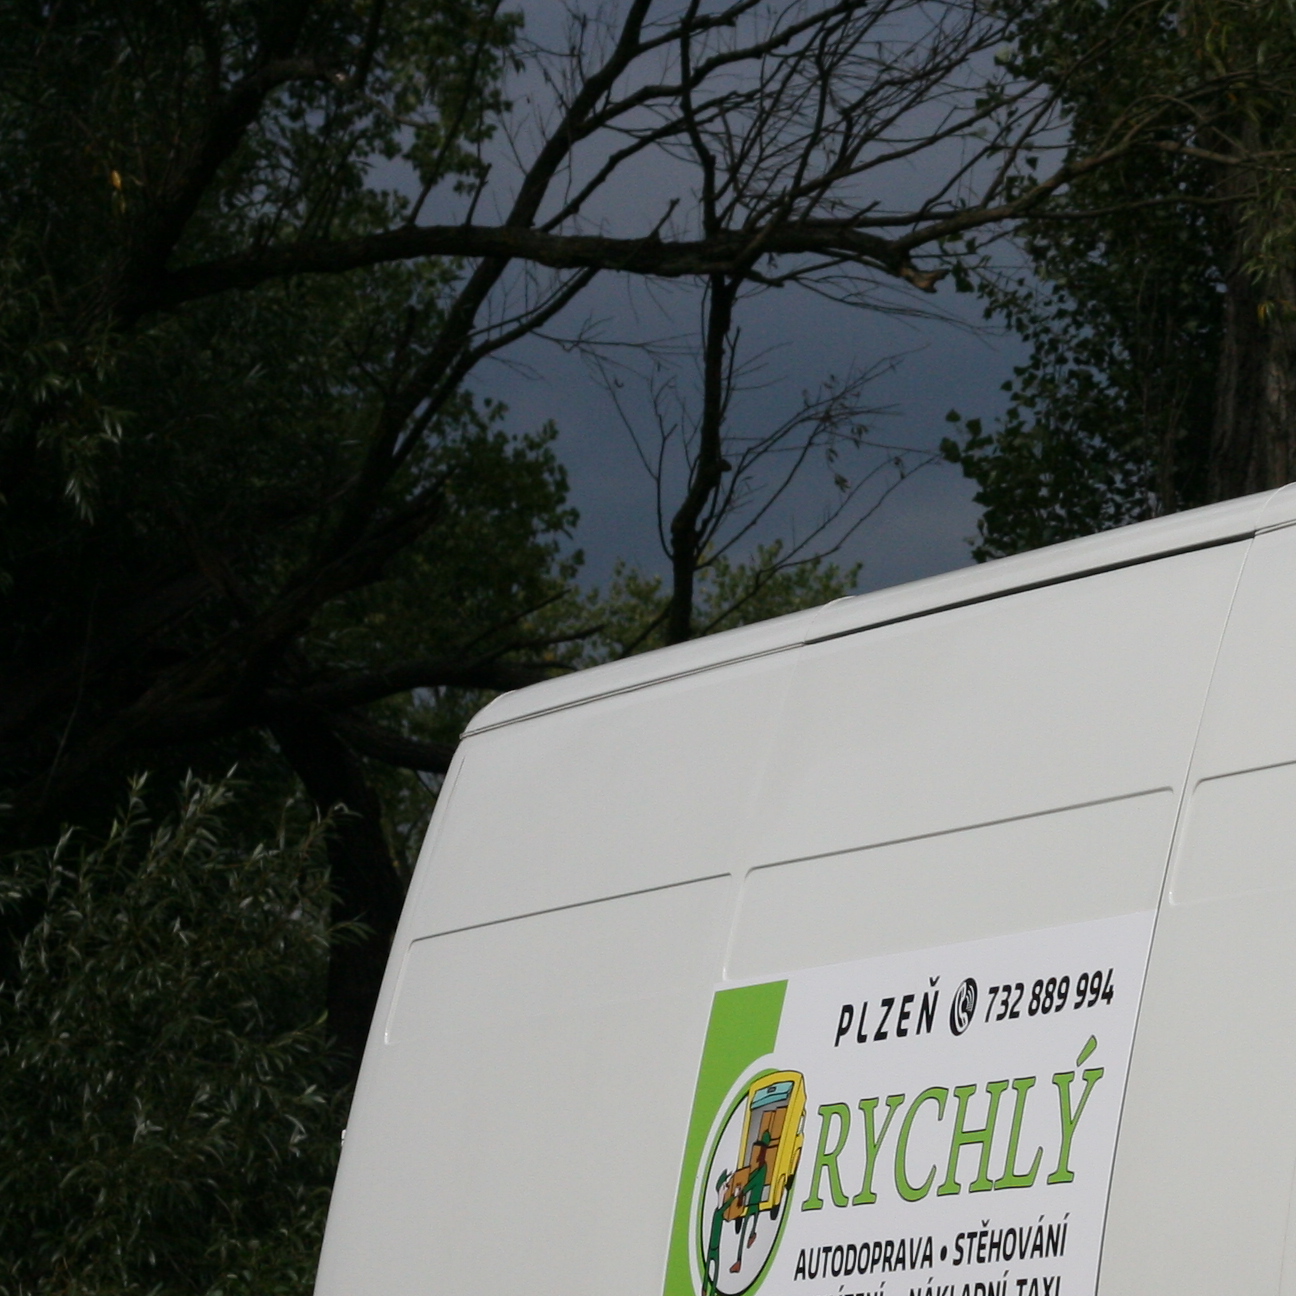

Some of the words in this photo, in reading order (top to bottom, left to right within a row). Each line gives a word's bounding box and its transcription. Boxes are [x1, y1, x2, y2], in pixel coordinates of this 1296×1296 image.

[834, 976, 940, 1047] PLZEŇ
[985, 983, 1023, 1023] 732
[1028, 975, 1071, 1016] 889
[1073, 968, 1115, 1010] 994
[801, 1035, 1104, 1211] RYCHLÝ
[794, 1235, 934, 1281] AUTODOPRAVA
[952, 1213, 1070, 1267] STĚHOVÁNÍ
